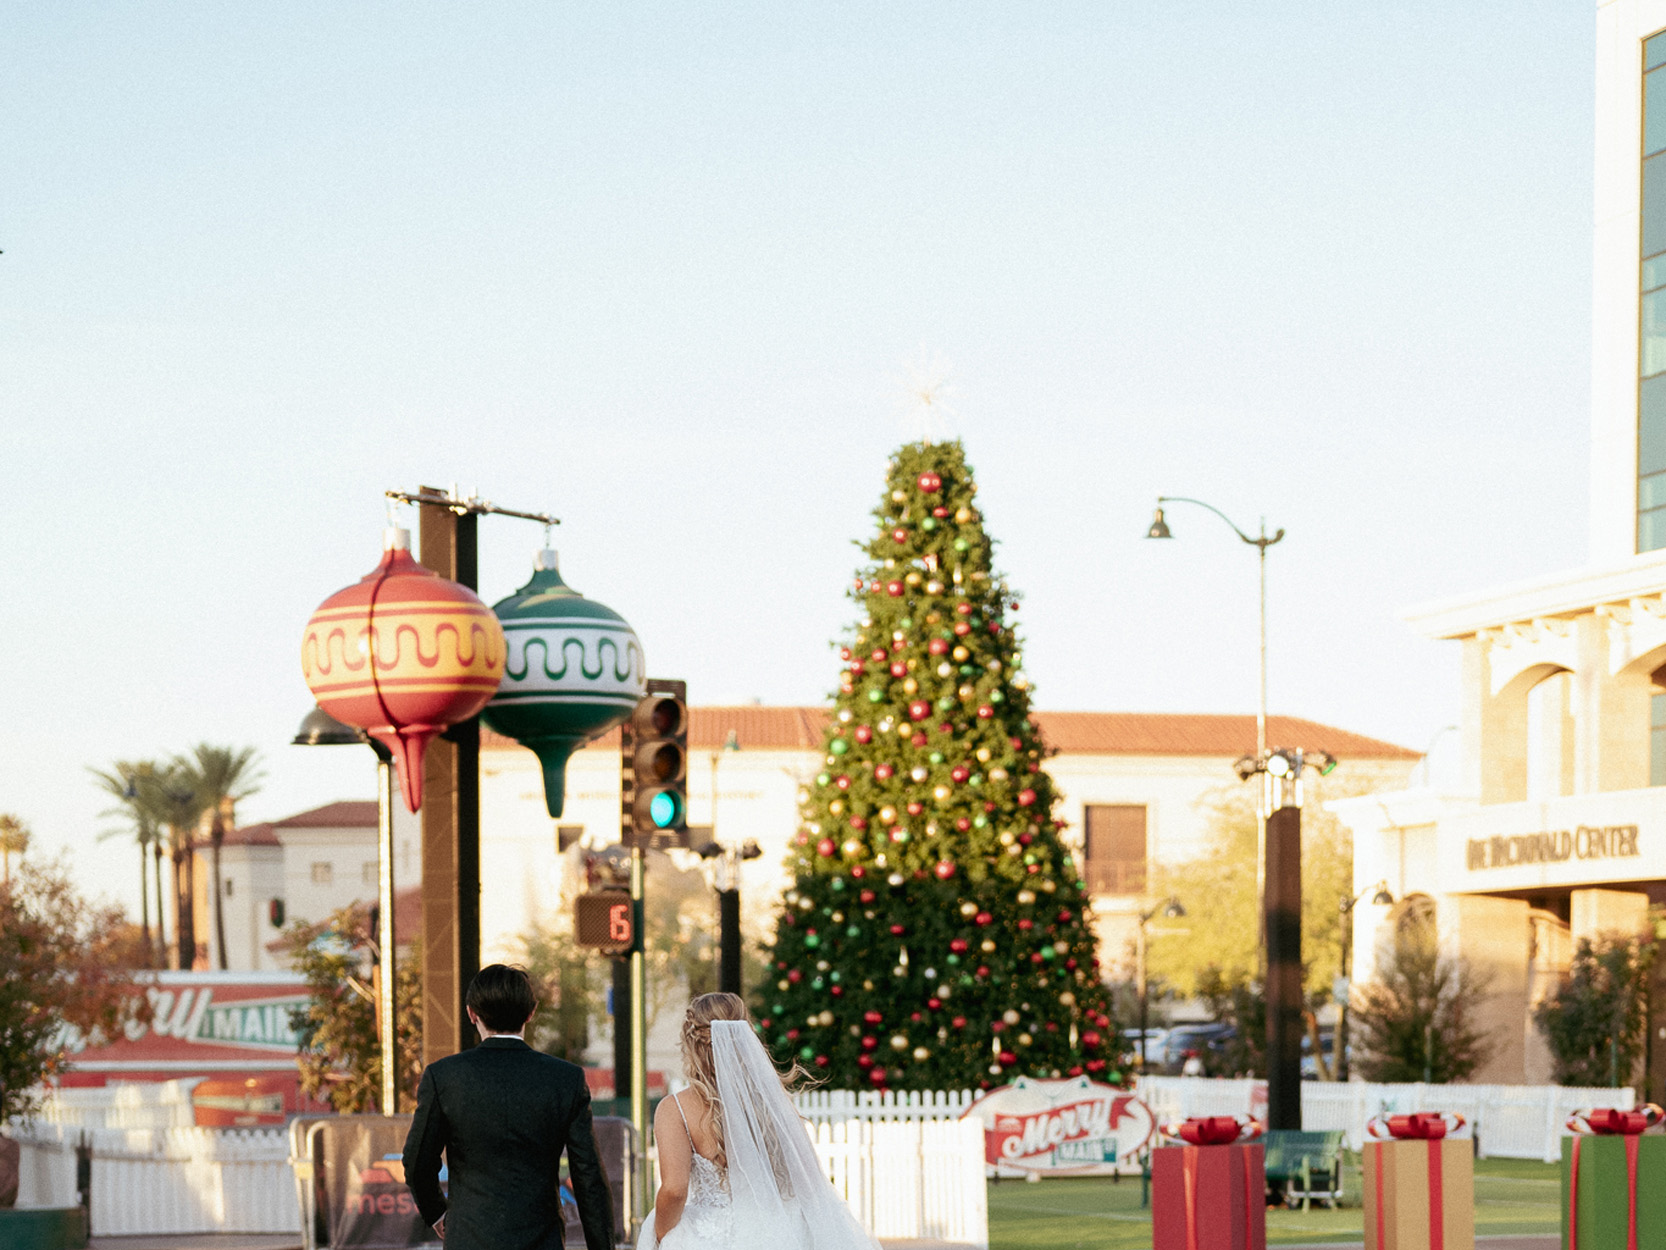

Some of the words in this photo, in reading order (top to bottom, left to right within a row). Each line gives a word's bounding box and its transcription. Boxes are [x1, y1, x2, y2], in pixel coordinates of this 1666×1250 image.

[1575, 824, 1639, 860] CENTER
[609, 904, 631, 941] 6
[1002, 1097, 1114, 1159] Merry
[346, 1192, 420, 1216] mes
